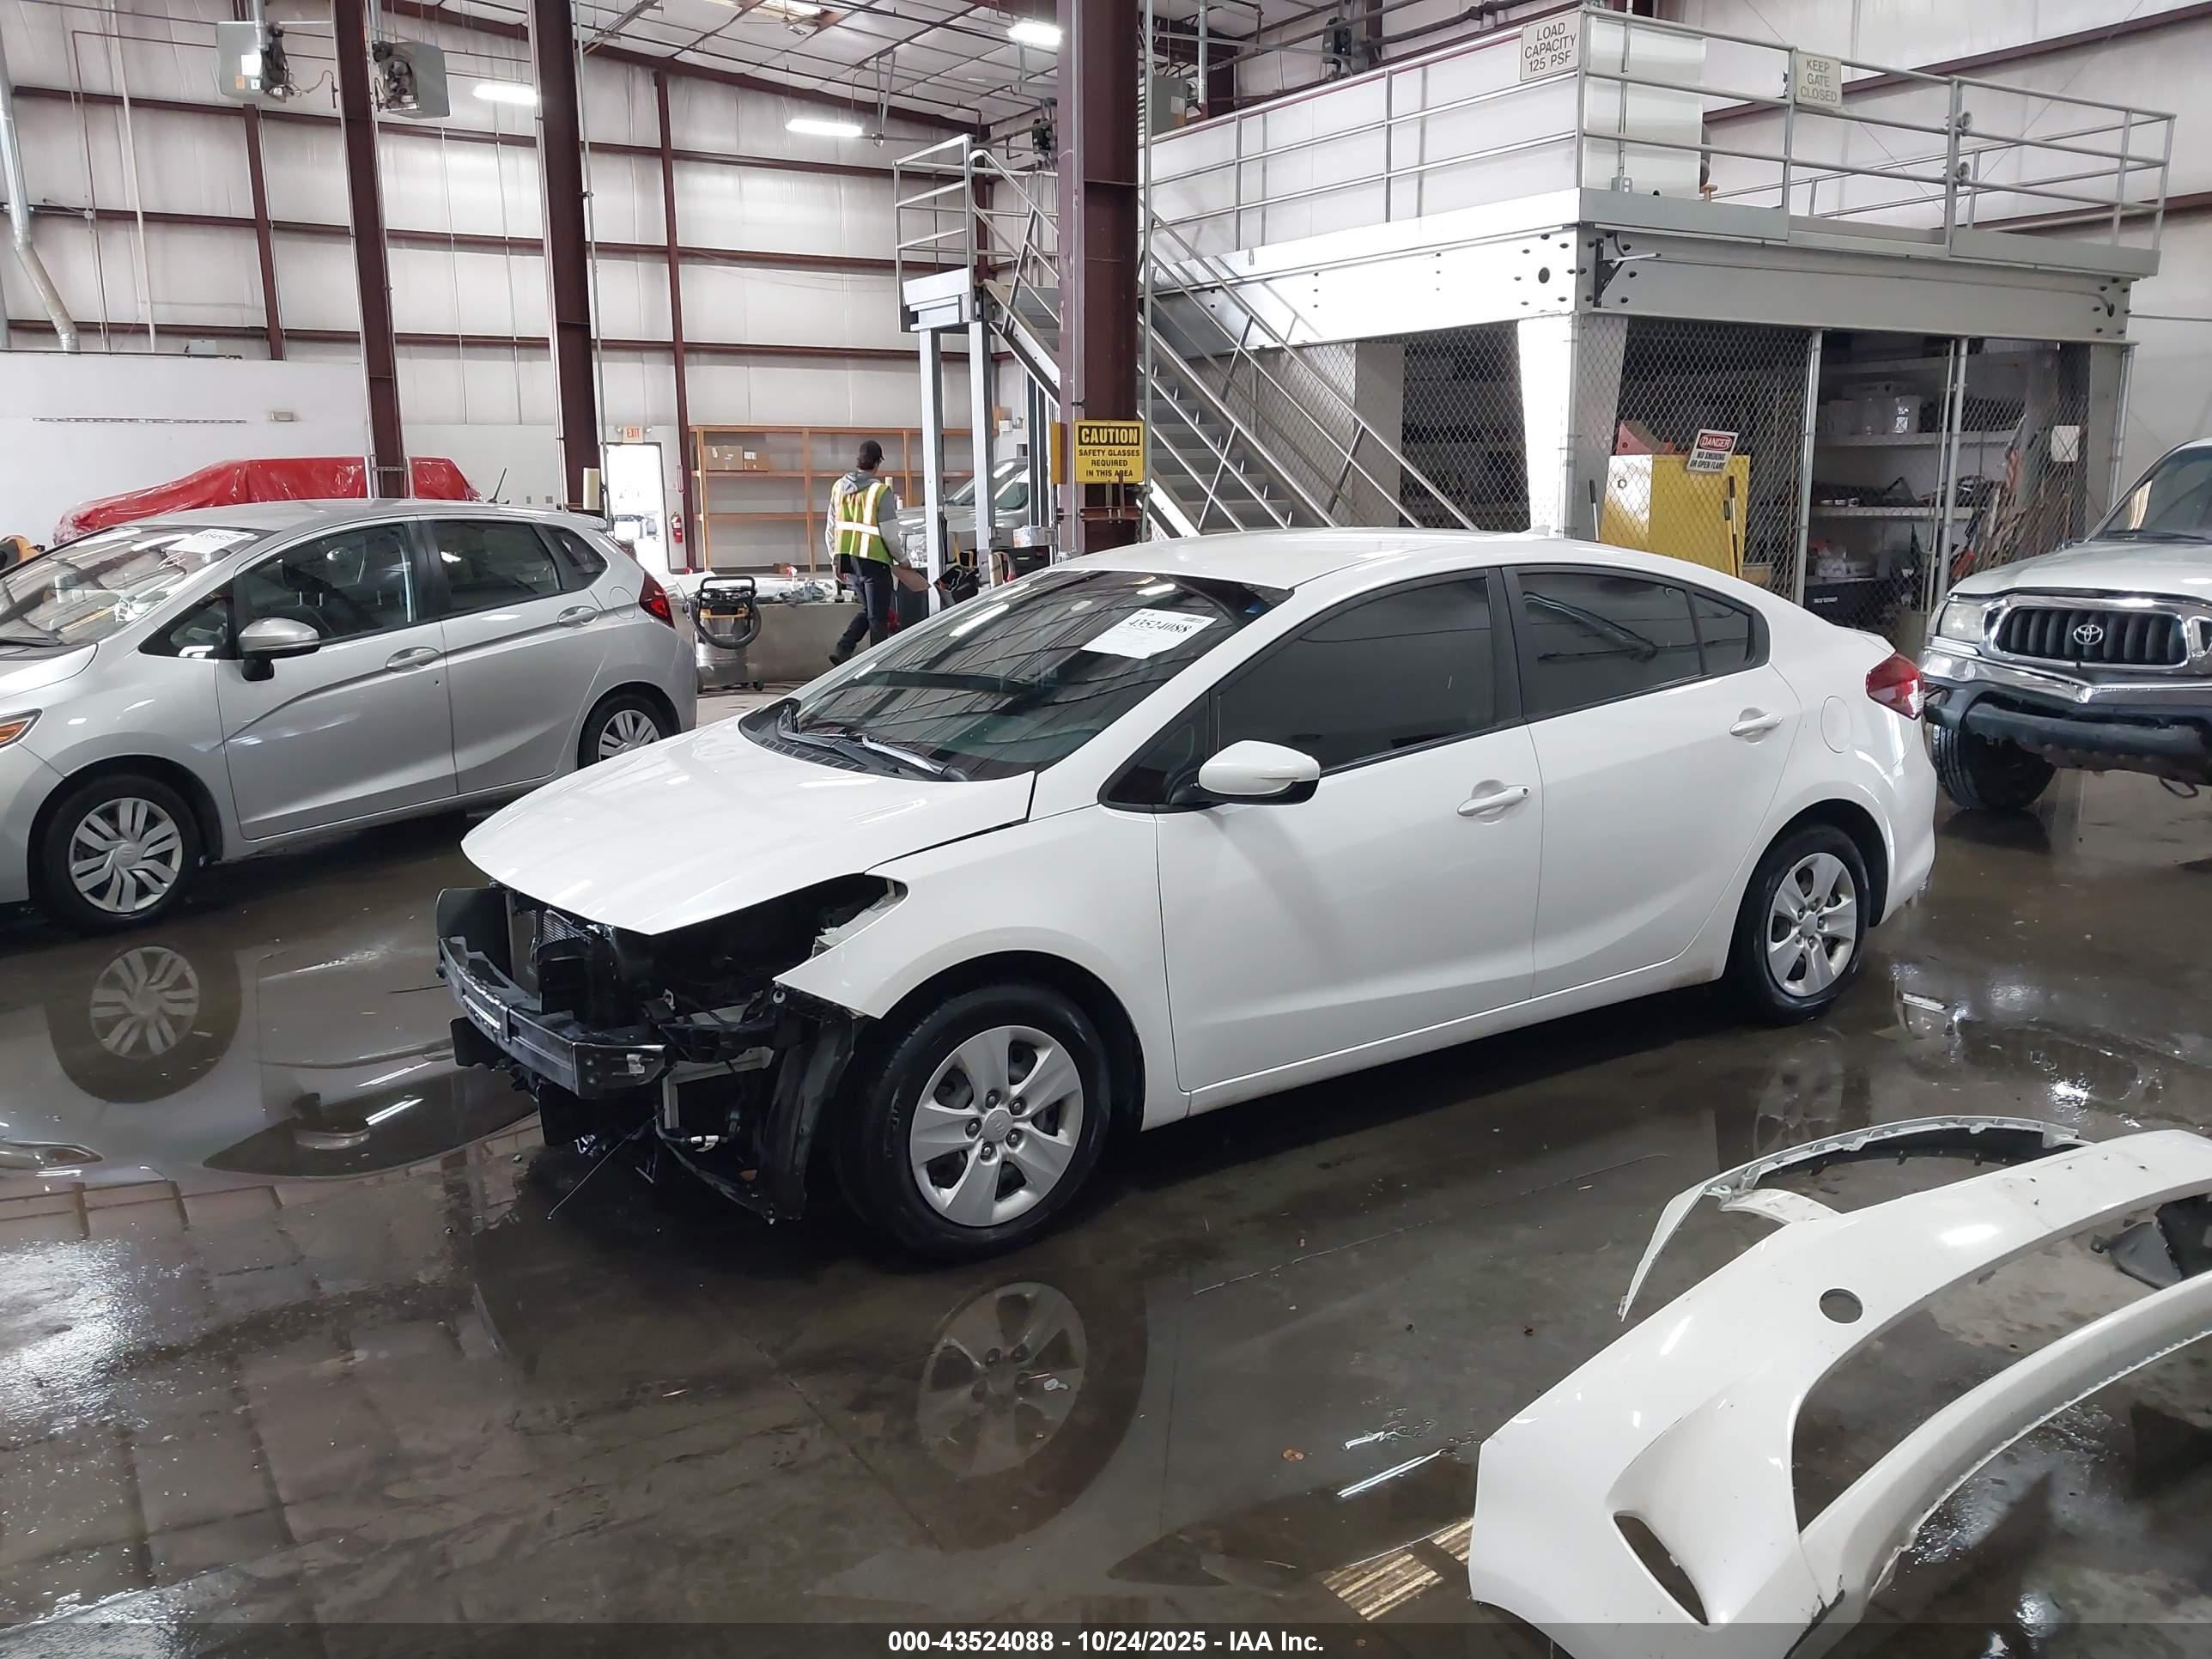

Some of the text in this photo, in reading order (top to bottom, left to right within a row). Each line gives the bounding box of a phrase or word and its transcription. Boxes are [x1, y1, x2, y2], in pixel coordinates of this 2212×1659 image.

[1536, 22, 1565, 41] LOAD
[1524, 34, 1577, 59] CAPACITY
[1528, 51, 1571, 73] 125 PSF
[1806, 59, 1830, 72] KEEP
[1807, 73, 1830, 88] GATE
[1800, 86, 1837, 102] CLOSED
[627, 428, 639, 438] EXIT
[1081, 428, 1137, 443] CAUTION
[1701, 437, 1730, 447] DANGER
[1698, 460, 1711, 469] OPEN
[1128, 618, 1192, 633] 43524088
